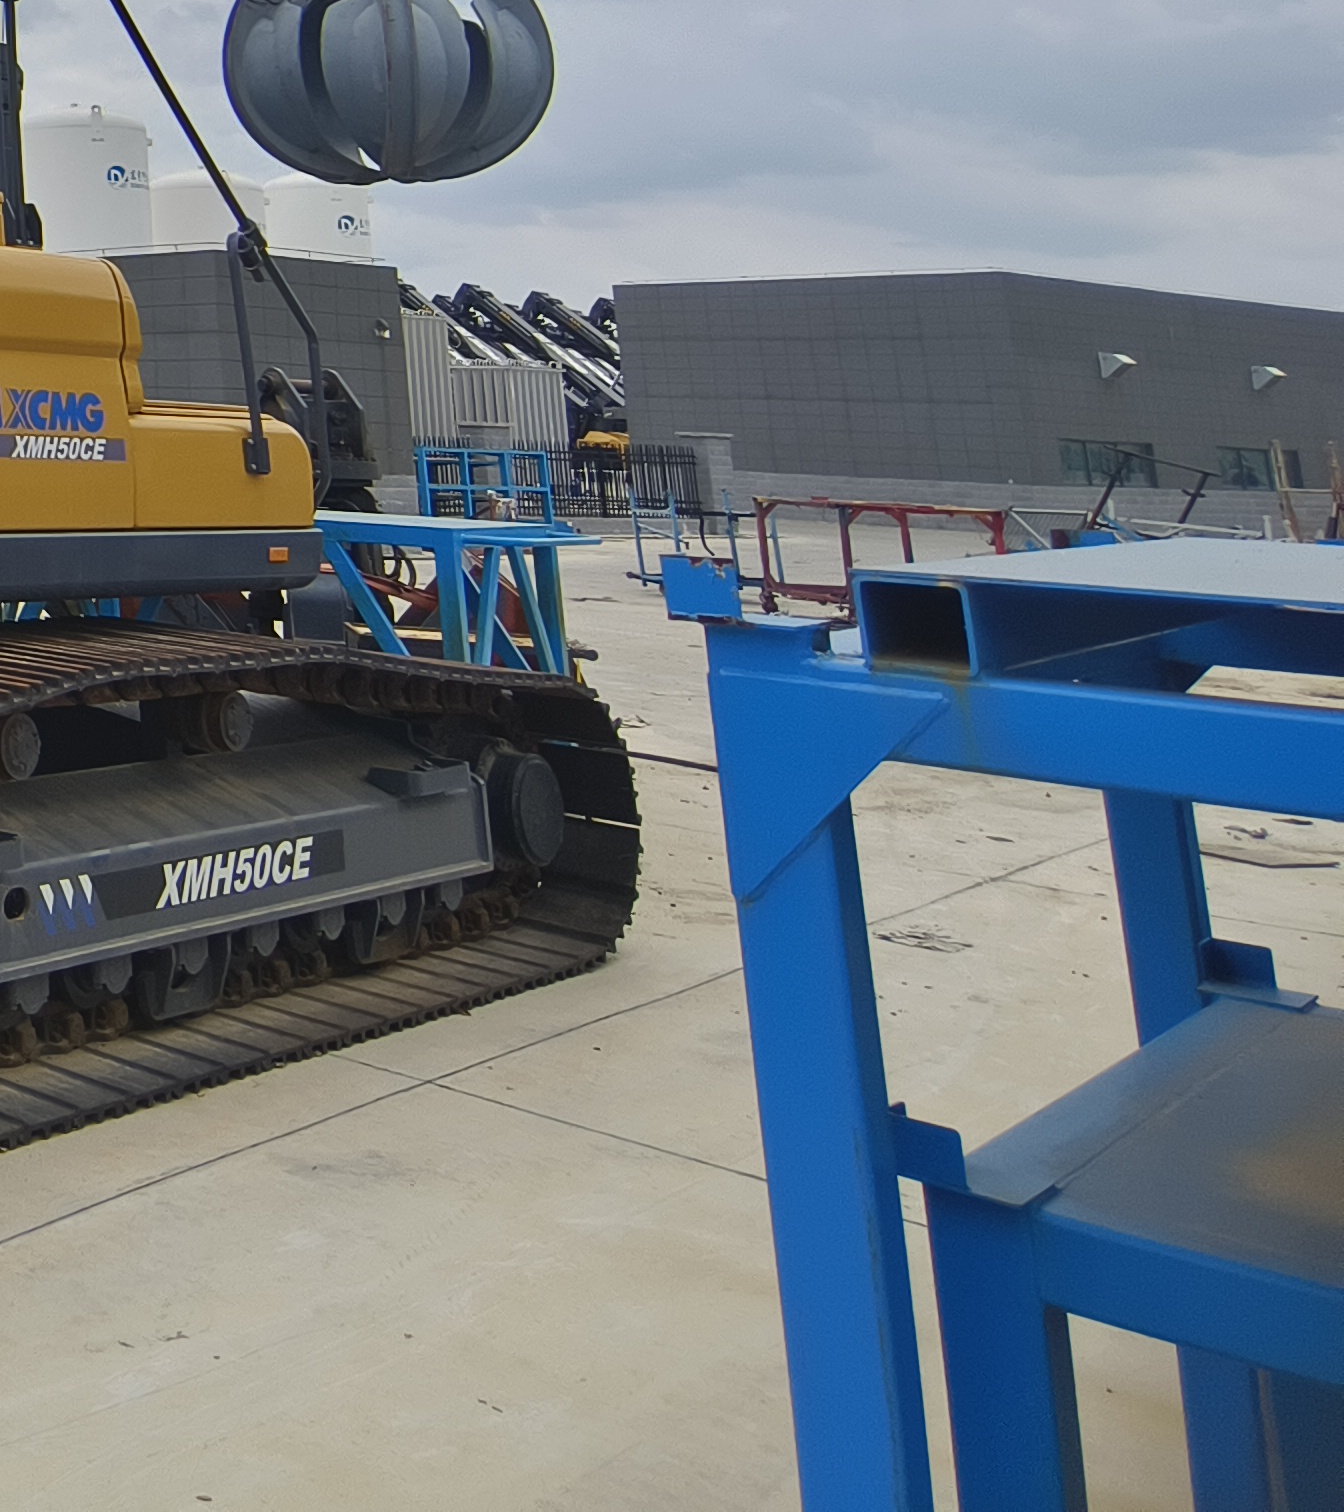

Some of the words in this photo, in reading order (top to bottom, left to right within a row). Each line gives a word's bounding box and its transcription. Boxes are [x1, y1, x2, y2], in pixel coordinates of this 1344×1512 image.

[3, 387, 105, 433] XCMG
[11, 434, 108, 461] XMH50CE
[155, 835, 314, 910] XMH50CE
